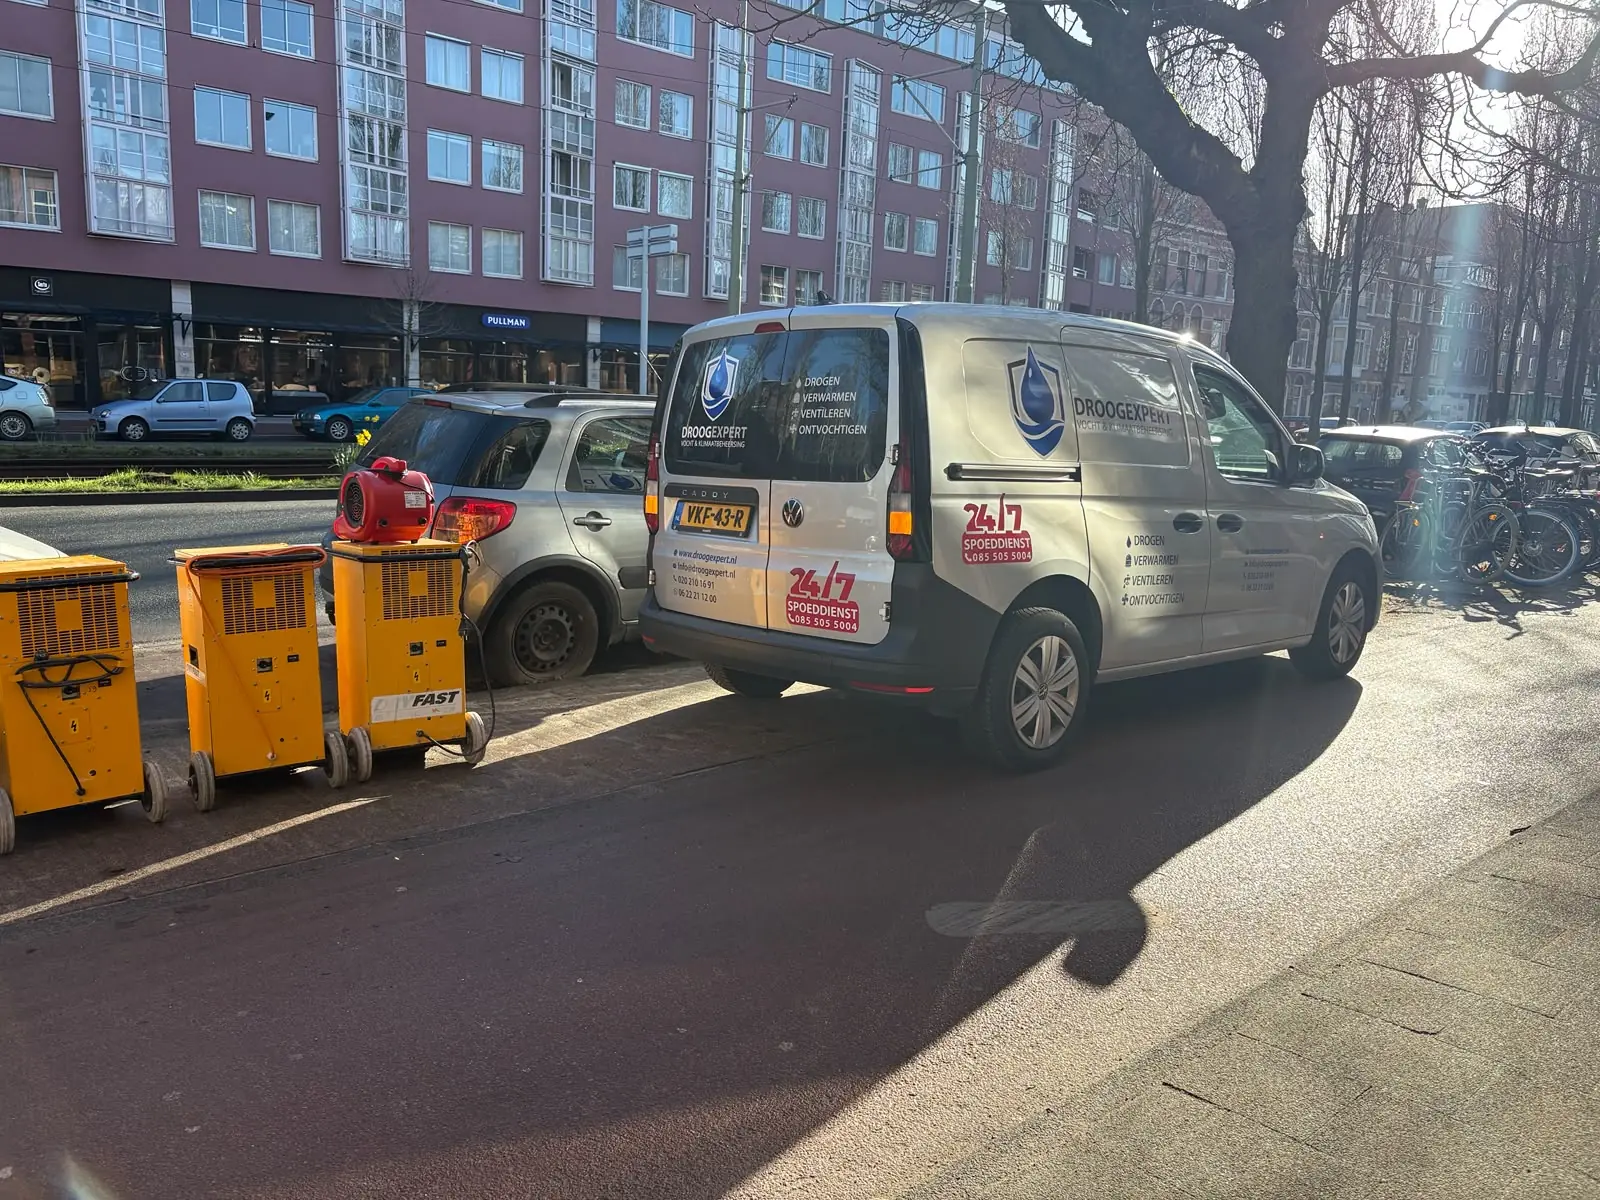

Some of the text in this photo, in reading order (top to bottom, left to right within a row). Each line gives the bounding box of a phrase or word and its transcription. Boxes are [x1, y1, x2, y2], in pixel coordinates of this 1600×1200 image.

[487, 316, 526, 327] PULLMAN
[804, 376, 841, 387] DROGEN
[802, 391, 857, 403] VERWARMEN
[800, 408, 851, 419] VENTILEREN
[1073, 397, 1171, 424] DROOGEXPERT
[798, 424, 867, 436] ONTVOCHTIGEN
[1076, 420, 1101, 430] VOCHT
[681, 425, 748, 439] DROOGEXPERT
[698, 440, 745, 449] KLIMAATBEHEERSING
[682, 489, 729, 498] CADDY
[687, 505, 744, 529] VKF-43-R
[962, 493, 1022, 532] 24/7
[964, 536, 1031, 550] SPOEDDIENST
[1134, 535, 1165, 546] DROGEN
[678, 549, 738, 565] www.droogexpert.nl
[972, 551, 1031, 562] 085 505 5004
[1133, 554, 1179, 566] VERWARMEN
[678, 575, 715, 589] 020 210 16 91
[790, 560, 856, 601] 24/7
[1132, 574, 1174, 586] VENTILEREN
[678, 588, 717, 603] 06 22 21 12 00
[1129, 593, 1185, 605] ONTVOCHTIGEN
[787, 600, 858, 620] SPOEDDIENST
[795, 614, 858, 631] 085 505 5004
[412, 690, 461, 707] FAST
